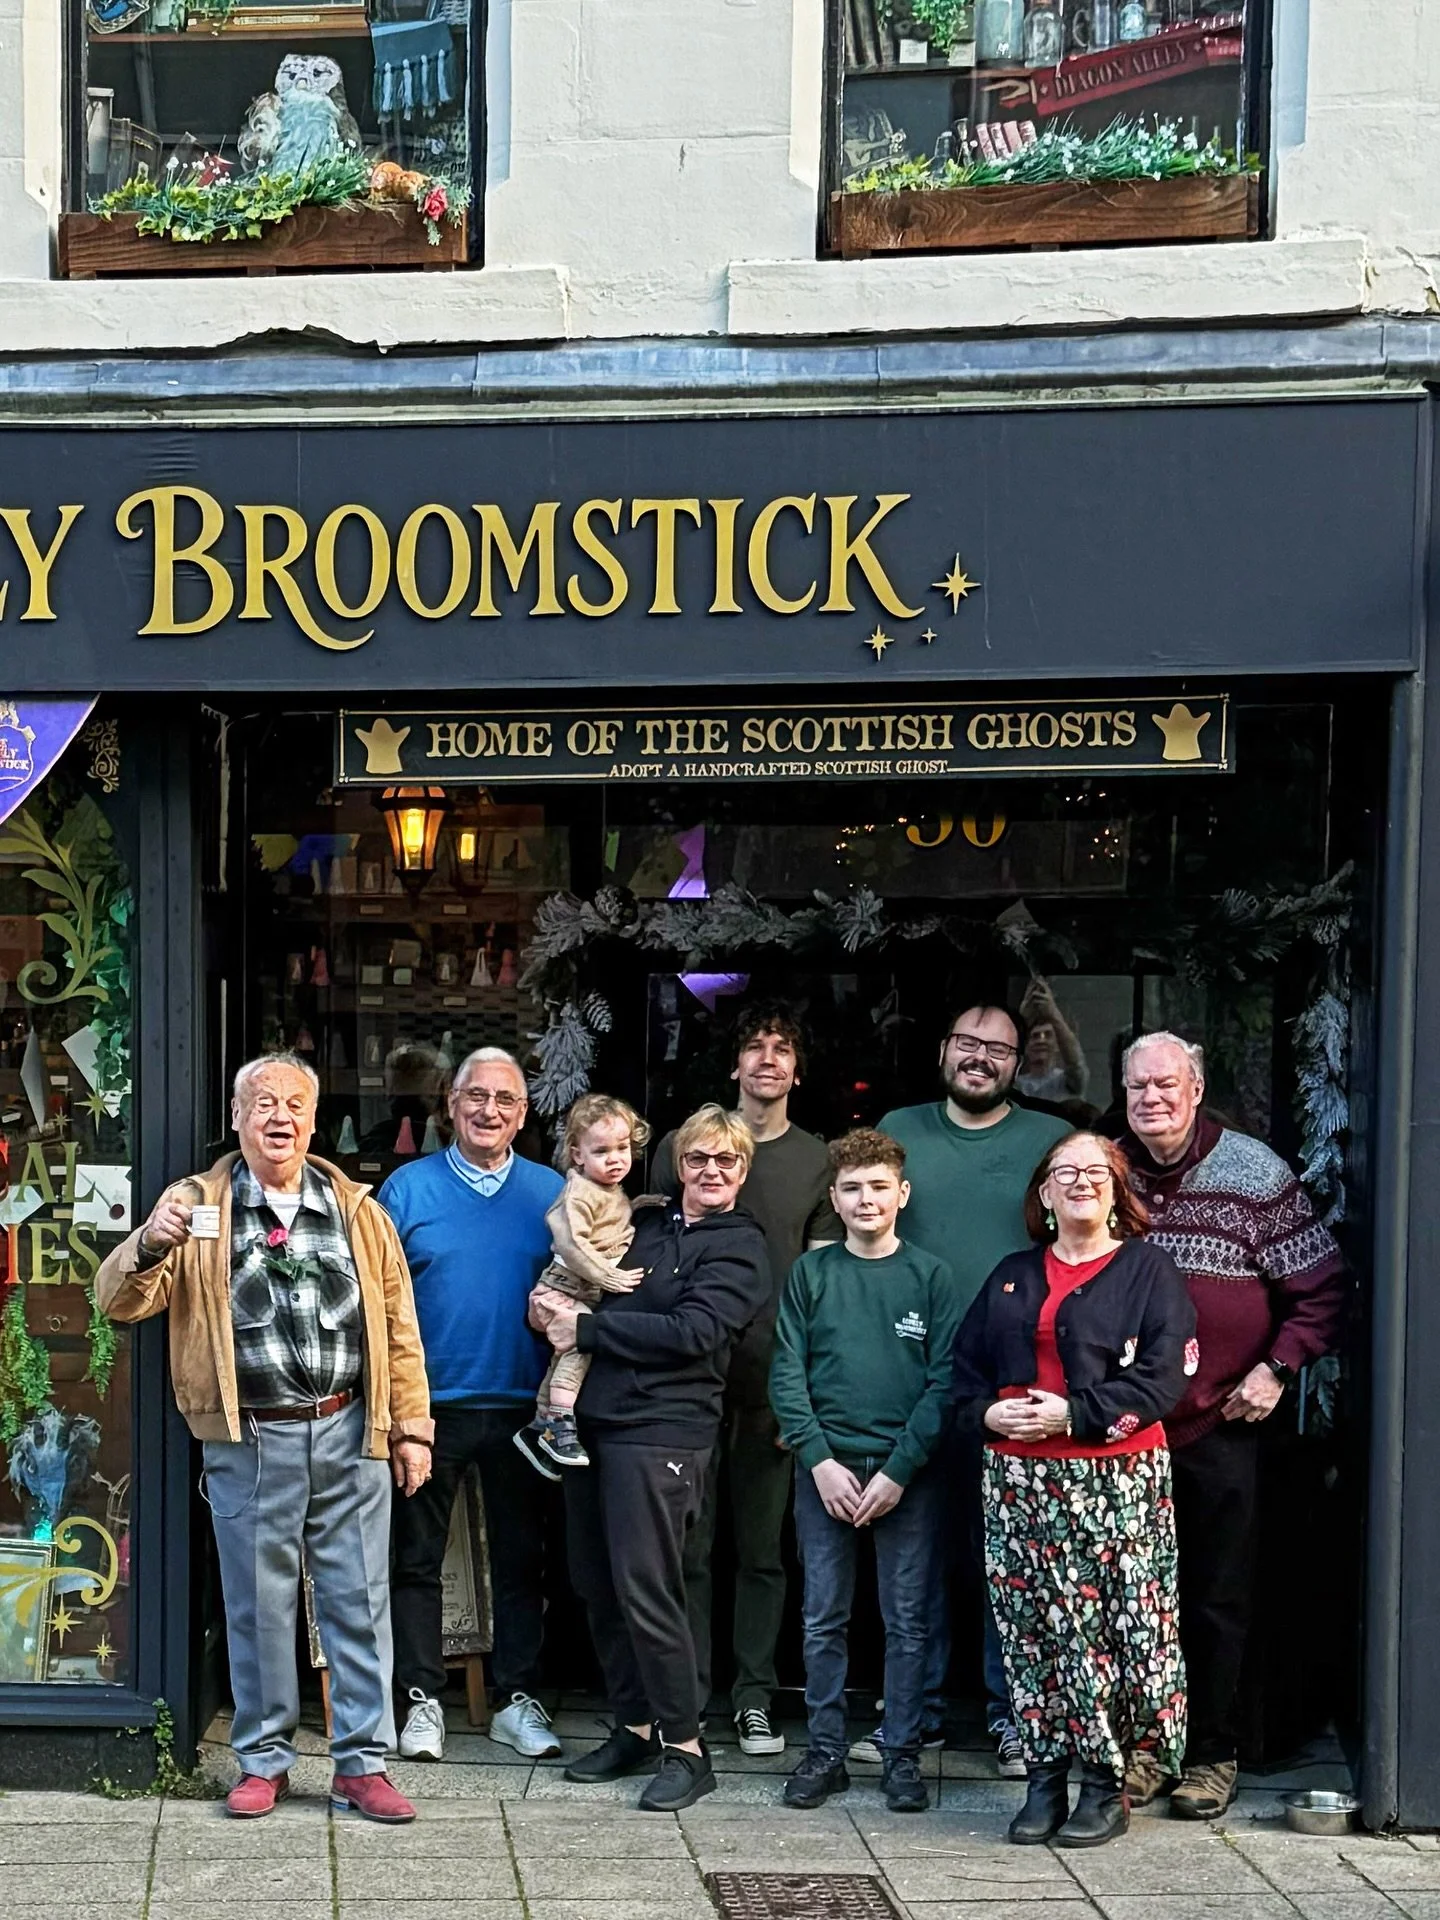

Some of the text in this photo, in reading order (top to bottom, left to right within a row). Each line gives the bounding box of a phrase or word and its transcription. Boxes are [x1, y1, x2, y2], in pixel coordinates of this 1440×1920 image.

[0, 485, 926, 651] Y BROOMSTICK
[426, 710, 1138, 758] HOME OF THE SCOTTISH GHOSTS
[608, 759, 949, 778] ADOPT A HANDCRAFTED SCOTTISH GHOST
